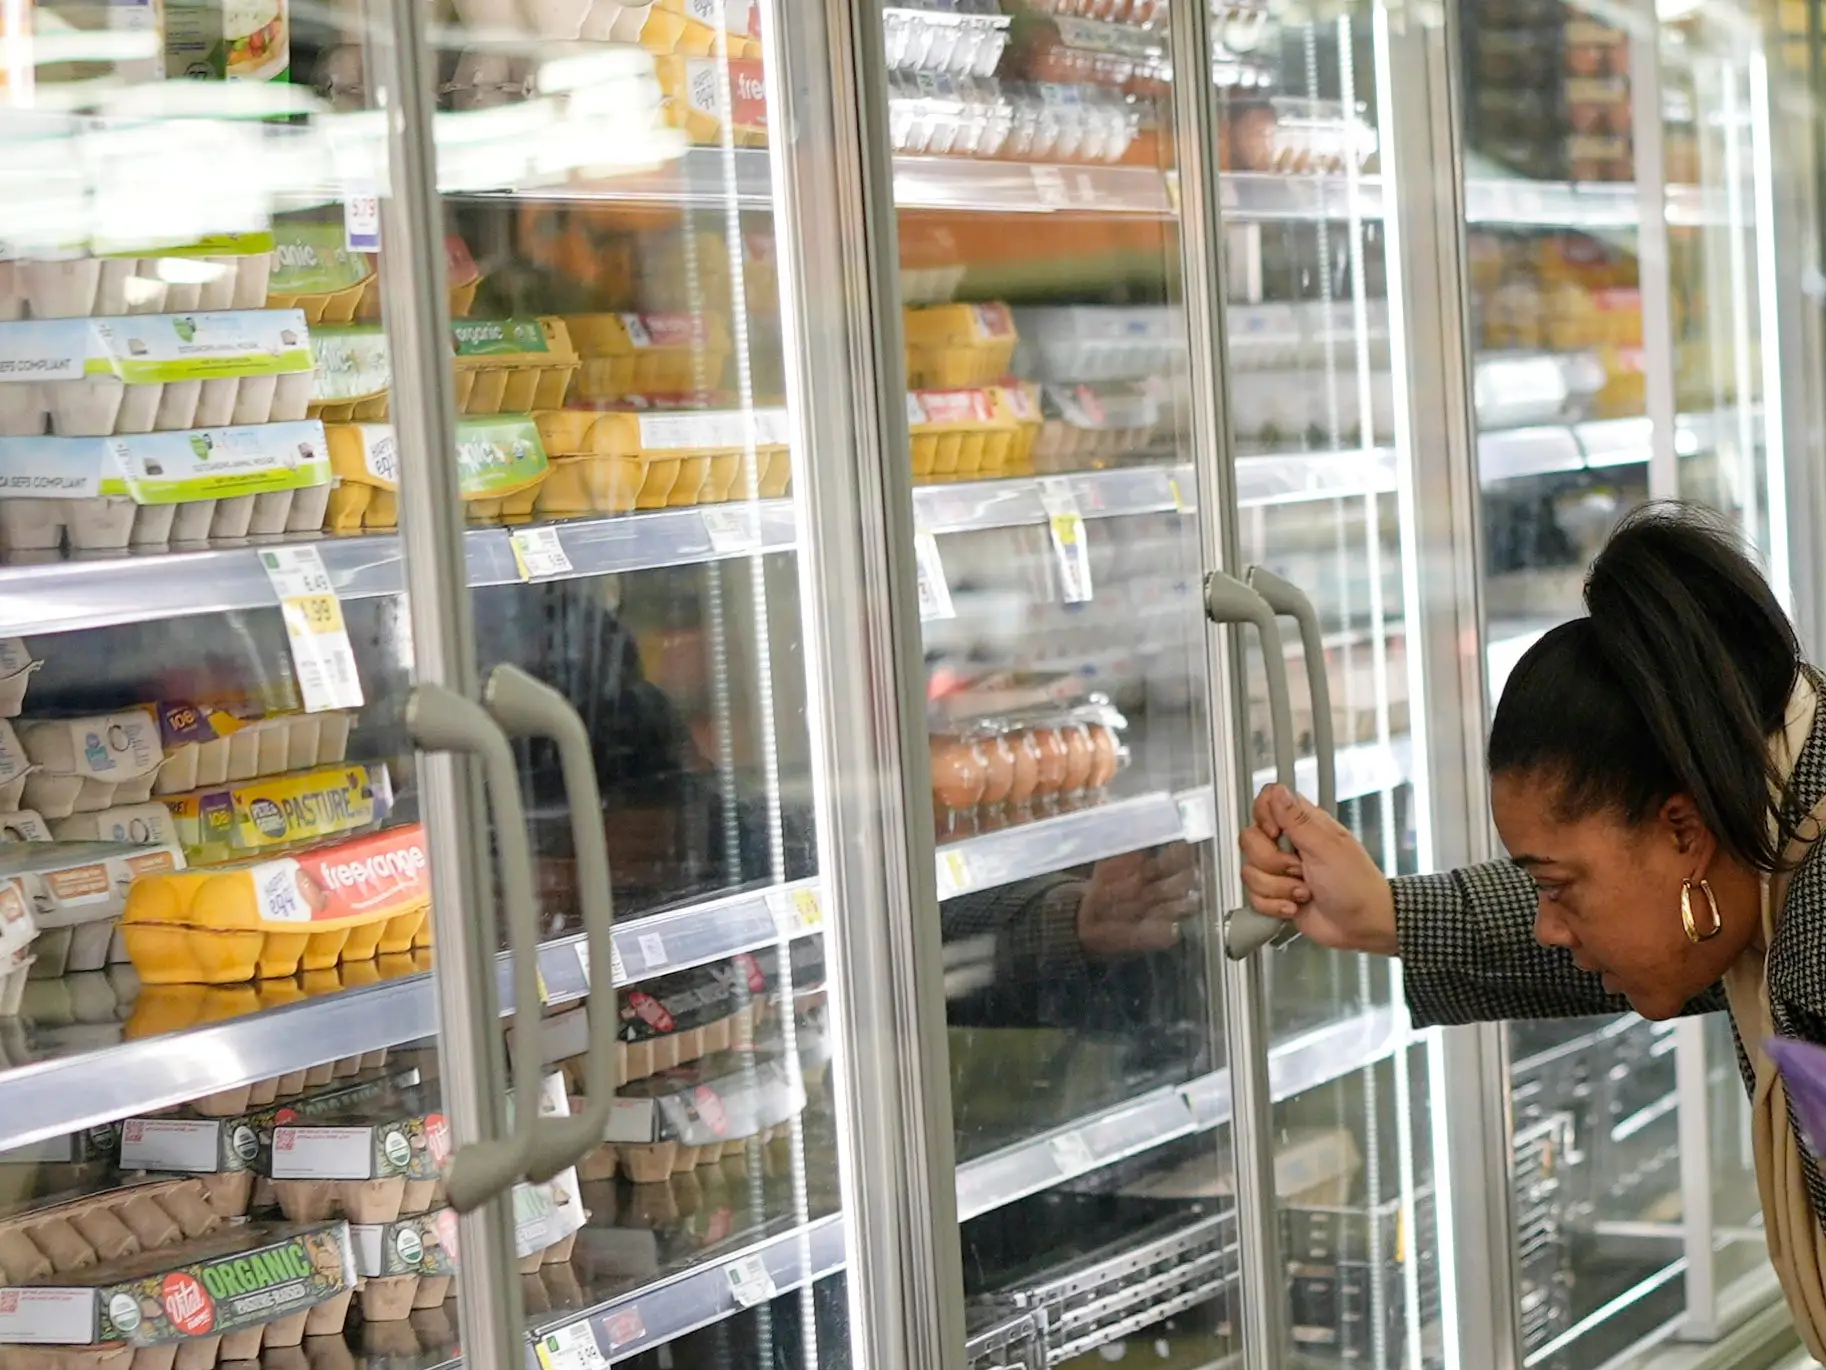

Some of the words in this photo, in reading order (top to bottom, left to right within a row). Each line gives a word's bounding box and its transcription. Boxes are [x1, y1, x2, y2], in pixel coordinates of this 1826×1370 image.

[454, 321, 504, 345] organic
[281, 786, 355, 829] PASTURE
[202, 1243, 311, 1301] ORGANIC
[165, 1279, 205, 1325] Vital
